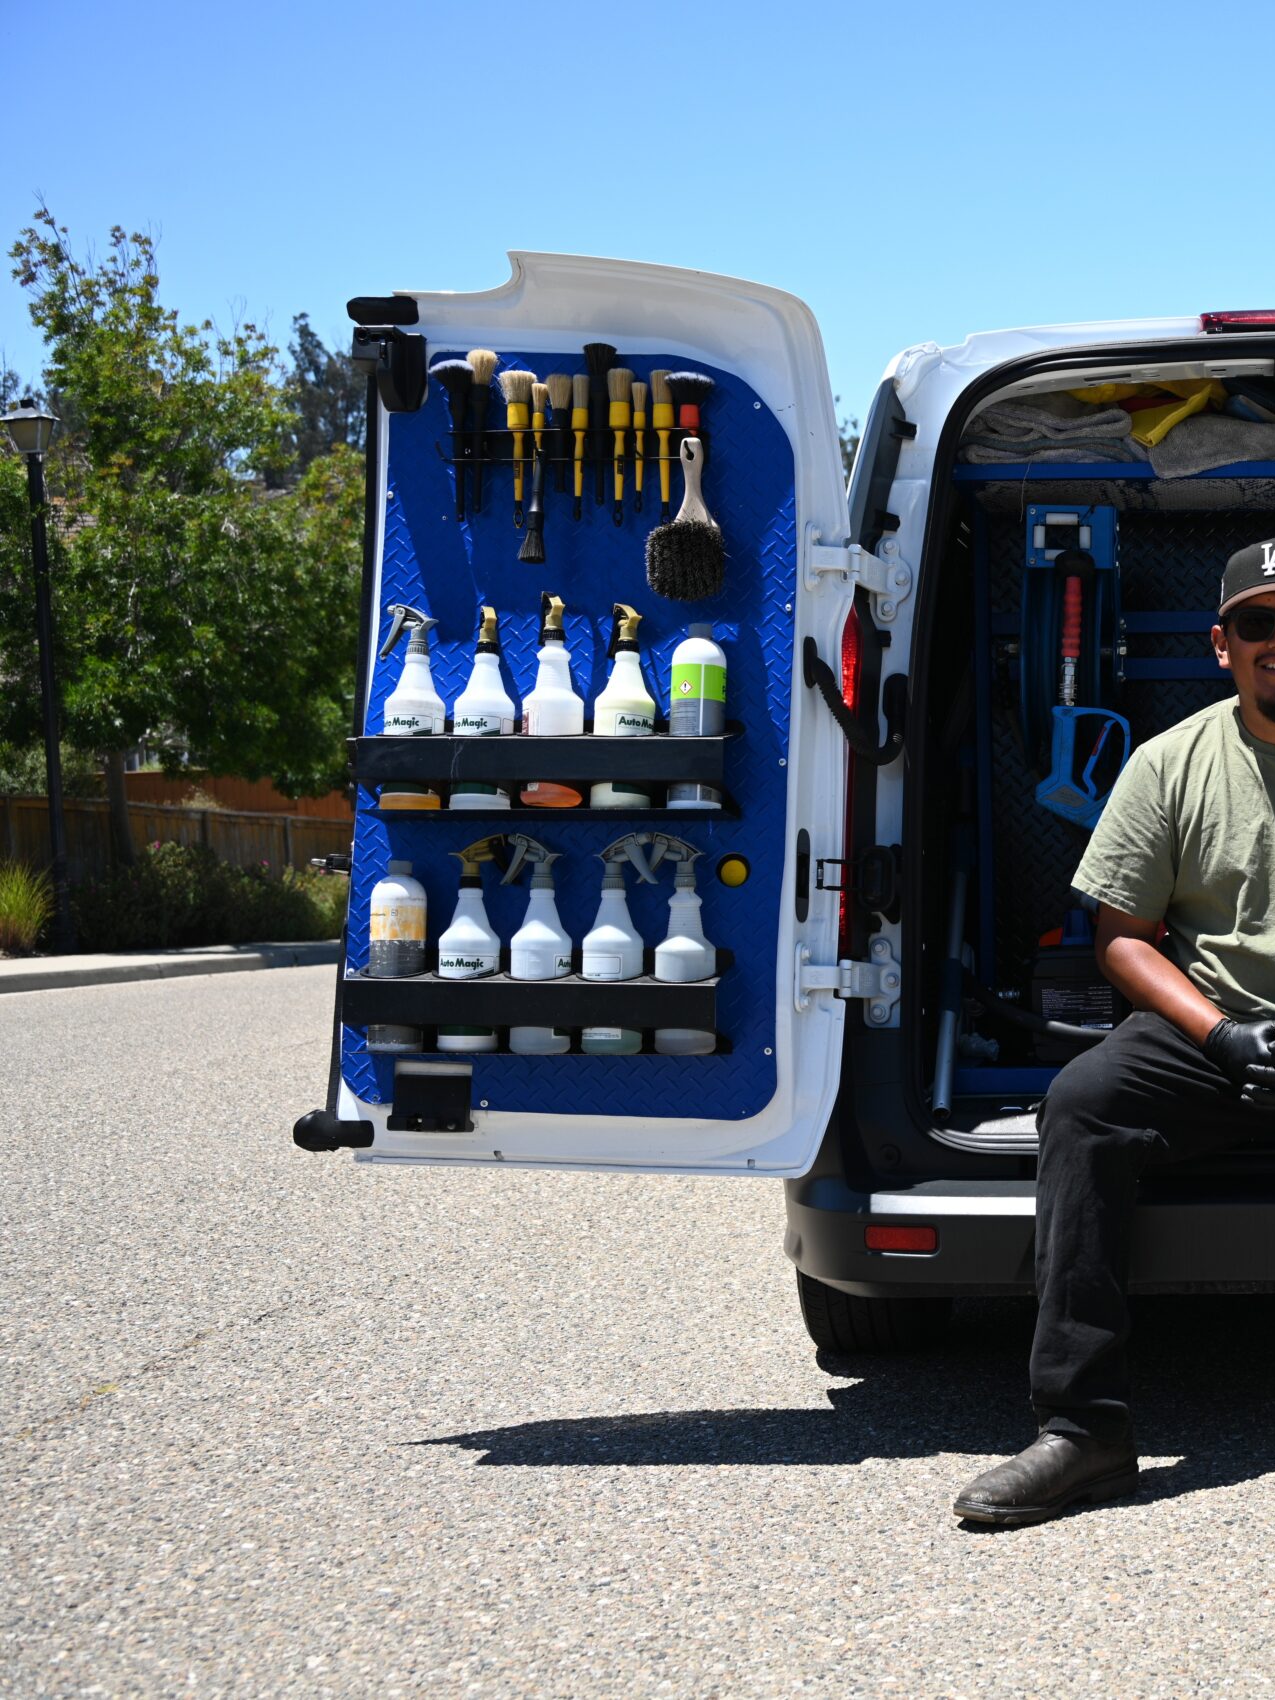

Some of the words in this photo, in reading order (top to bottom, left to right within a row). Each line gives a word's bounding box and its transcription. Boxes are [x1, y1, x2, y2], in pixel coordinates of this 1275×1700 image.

[392, 717, 419, 728] Magic
[461, 718, 487, 729] Magic
[618, 716, 640, 727] Auto
[440, 958, 454, 968] Auto
[455, 957, 484, 970] Magic
